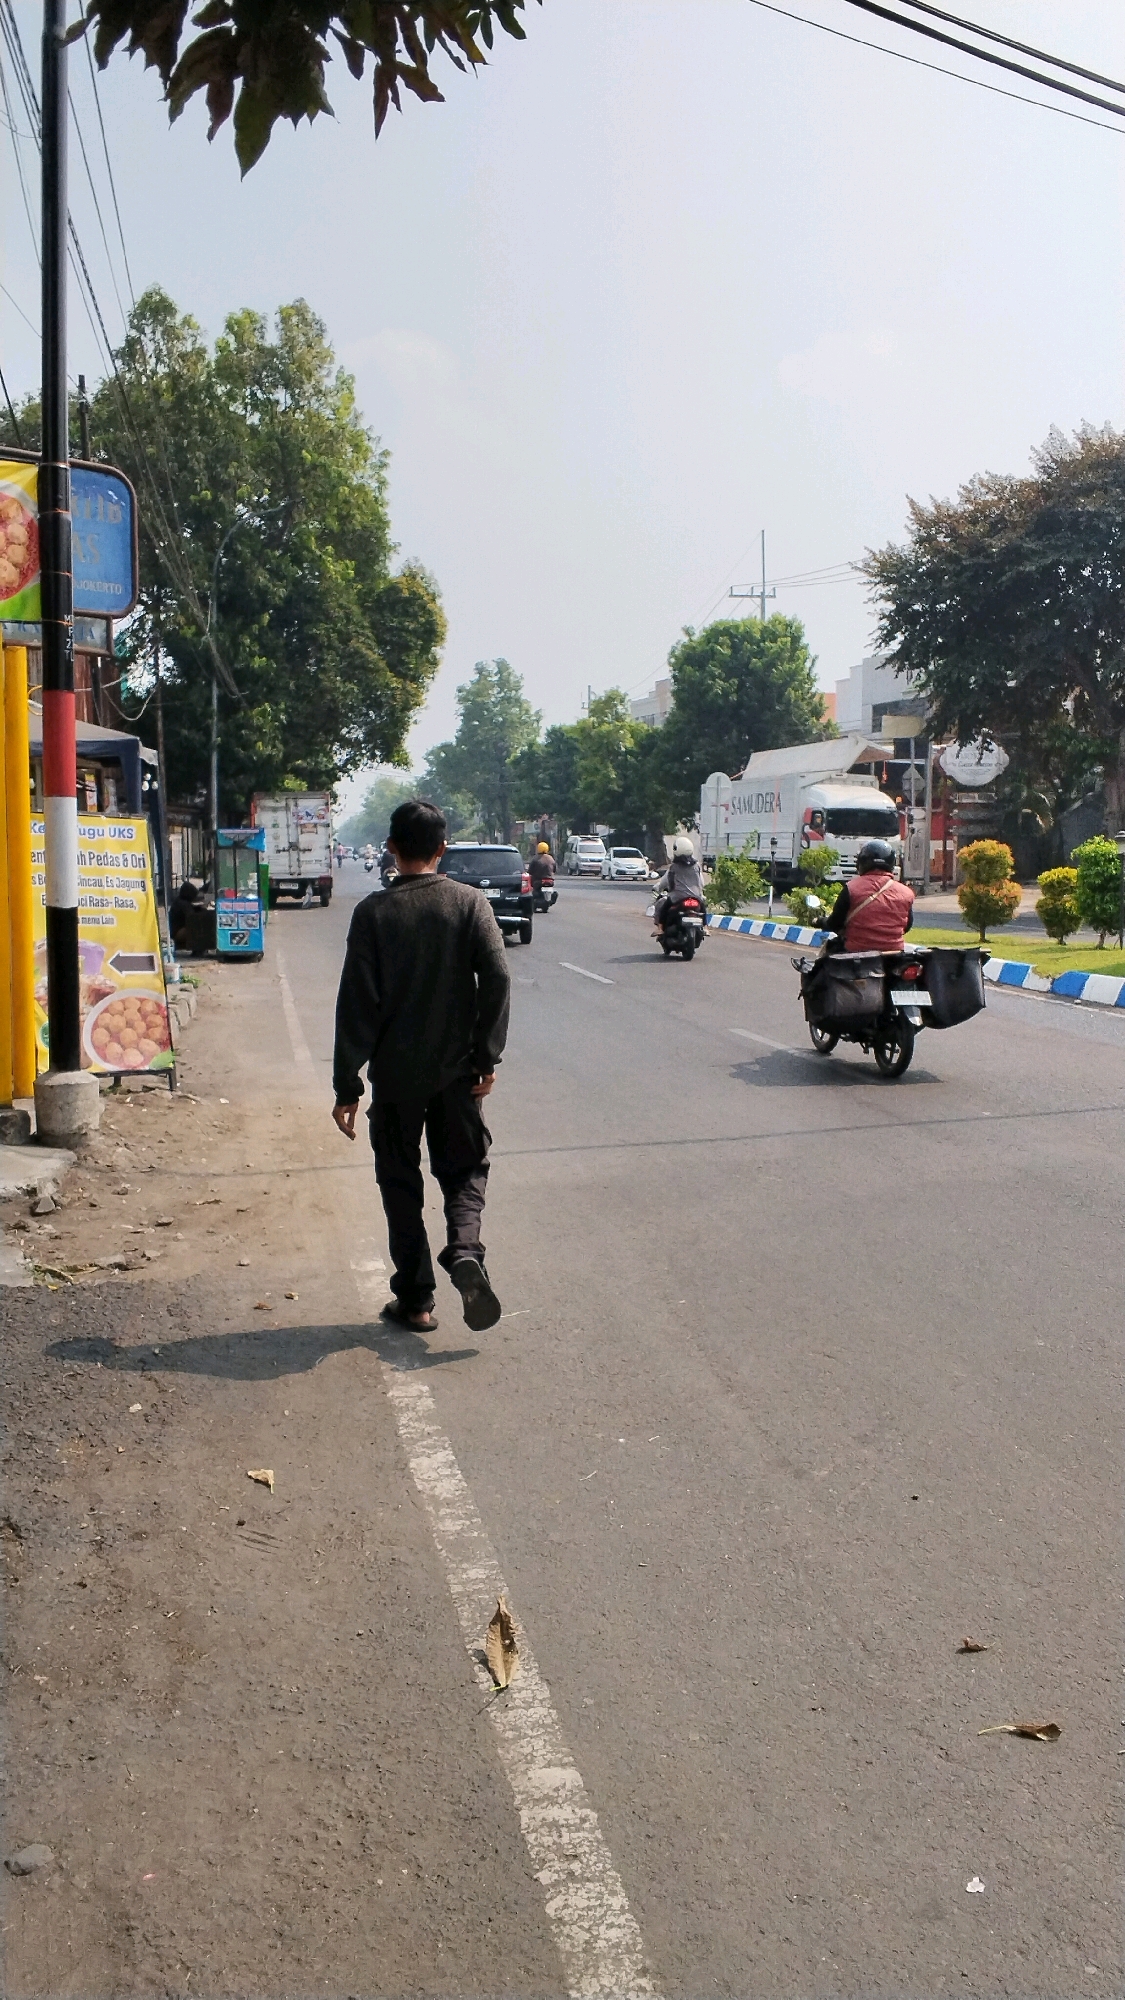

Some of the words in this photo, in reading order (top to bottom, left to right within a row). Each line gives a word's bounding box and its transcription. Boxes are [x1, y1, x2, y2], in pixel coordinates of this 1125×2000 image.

[731, 792, 782, 815] SAMUDERA
[77, 826, 105, 839] ugu
[108, 827, 134, 839] UKS
[88, 851, 120, 868] Pedas
[122, 854, 129, 868] &
[130, 853, 147, 869] Ori
[105, 876, 115, 888] Es
[115, 877, 147, 892] Jagung
